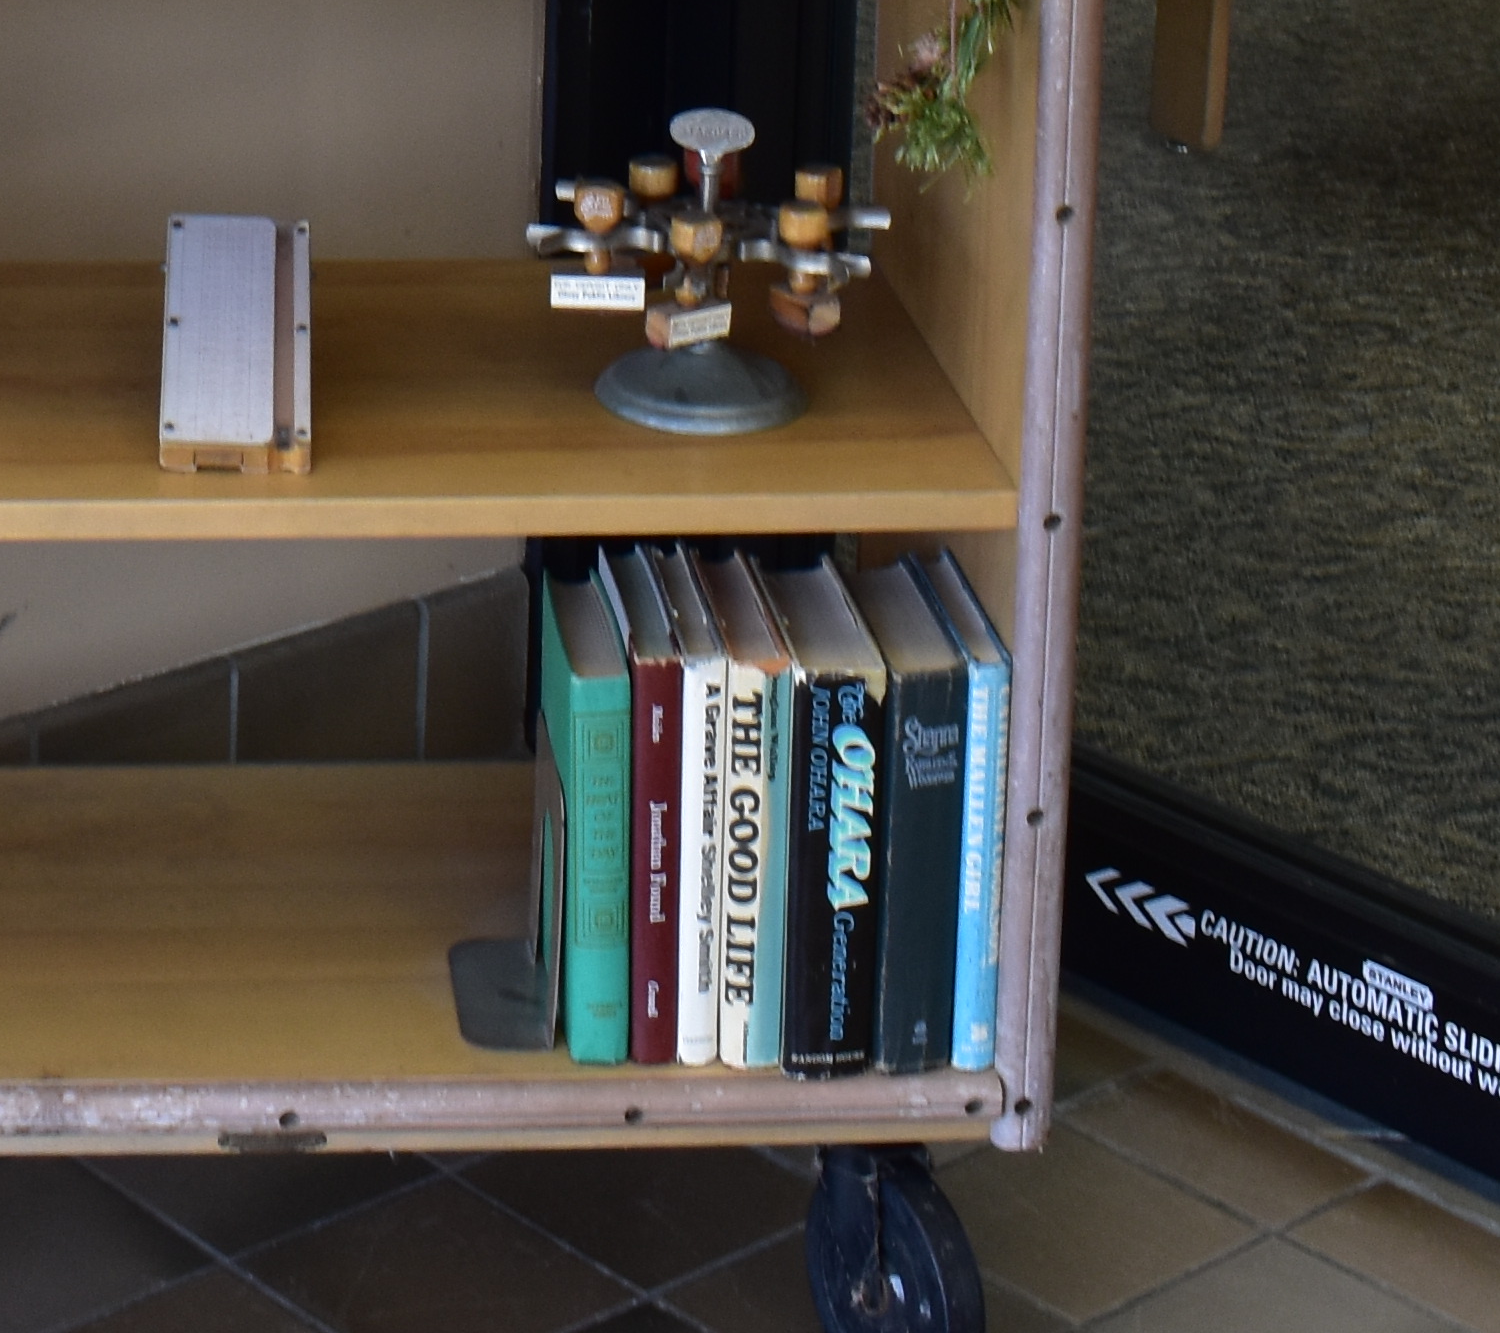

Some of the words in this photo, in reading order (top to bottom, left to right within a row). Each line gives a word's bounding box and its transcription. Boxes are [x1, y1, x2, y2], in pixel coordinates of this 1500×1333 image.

[705, 683, 721, 699] A
[810, 683, 831, 748] JOHN
[971, 686, 989, 740] THE
[703, 704, 721, 770] Grave
[731, 689, 764, 778] THE
[701, 773, 719, 839] Affair
[967, 744, 987, 848] MALLEN
[726, 786, 762, 906] GOOD
[964, 850, 984, 915] GIRL
[696, 844, 718, 925] Shelley
[697, 929, 715, 995] Smith
[723, 913, 757, 1007] LIFE
[830, 911, 855, 1041] Generation
[1200, 909, 1302, 979] CAUTION:
[1307, 958, 1438, 1042] AUTOMATIC
[1367, 963, 1430, 1007] STANLEY
[1229, 947, 1278, 991] Door
[1281, 975, 1322, 1019] may
[1329, 991, 1386, 1042] close
[1391, 1024, 1474, 1086] without
